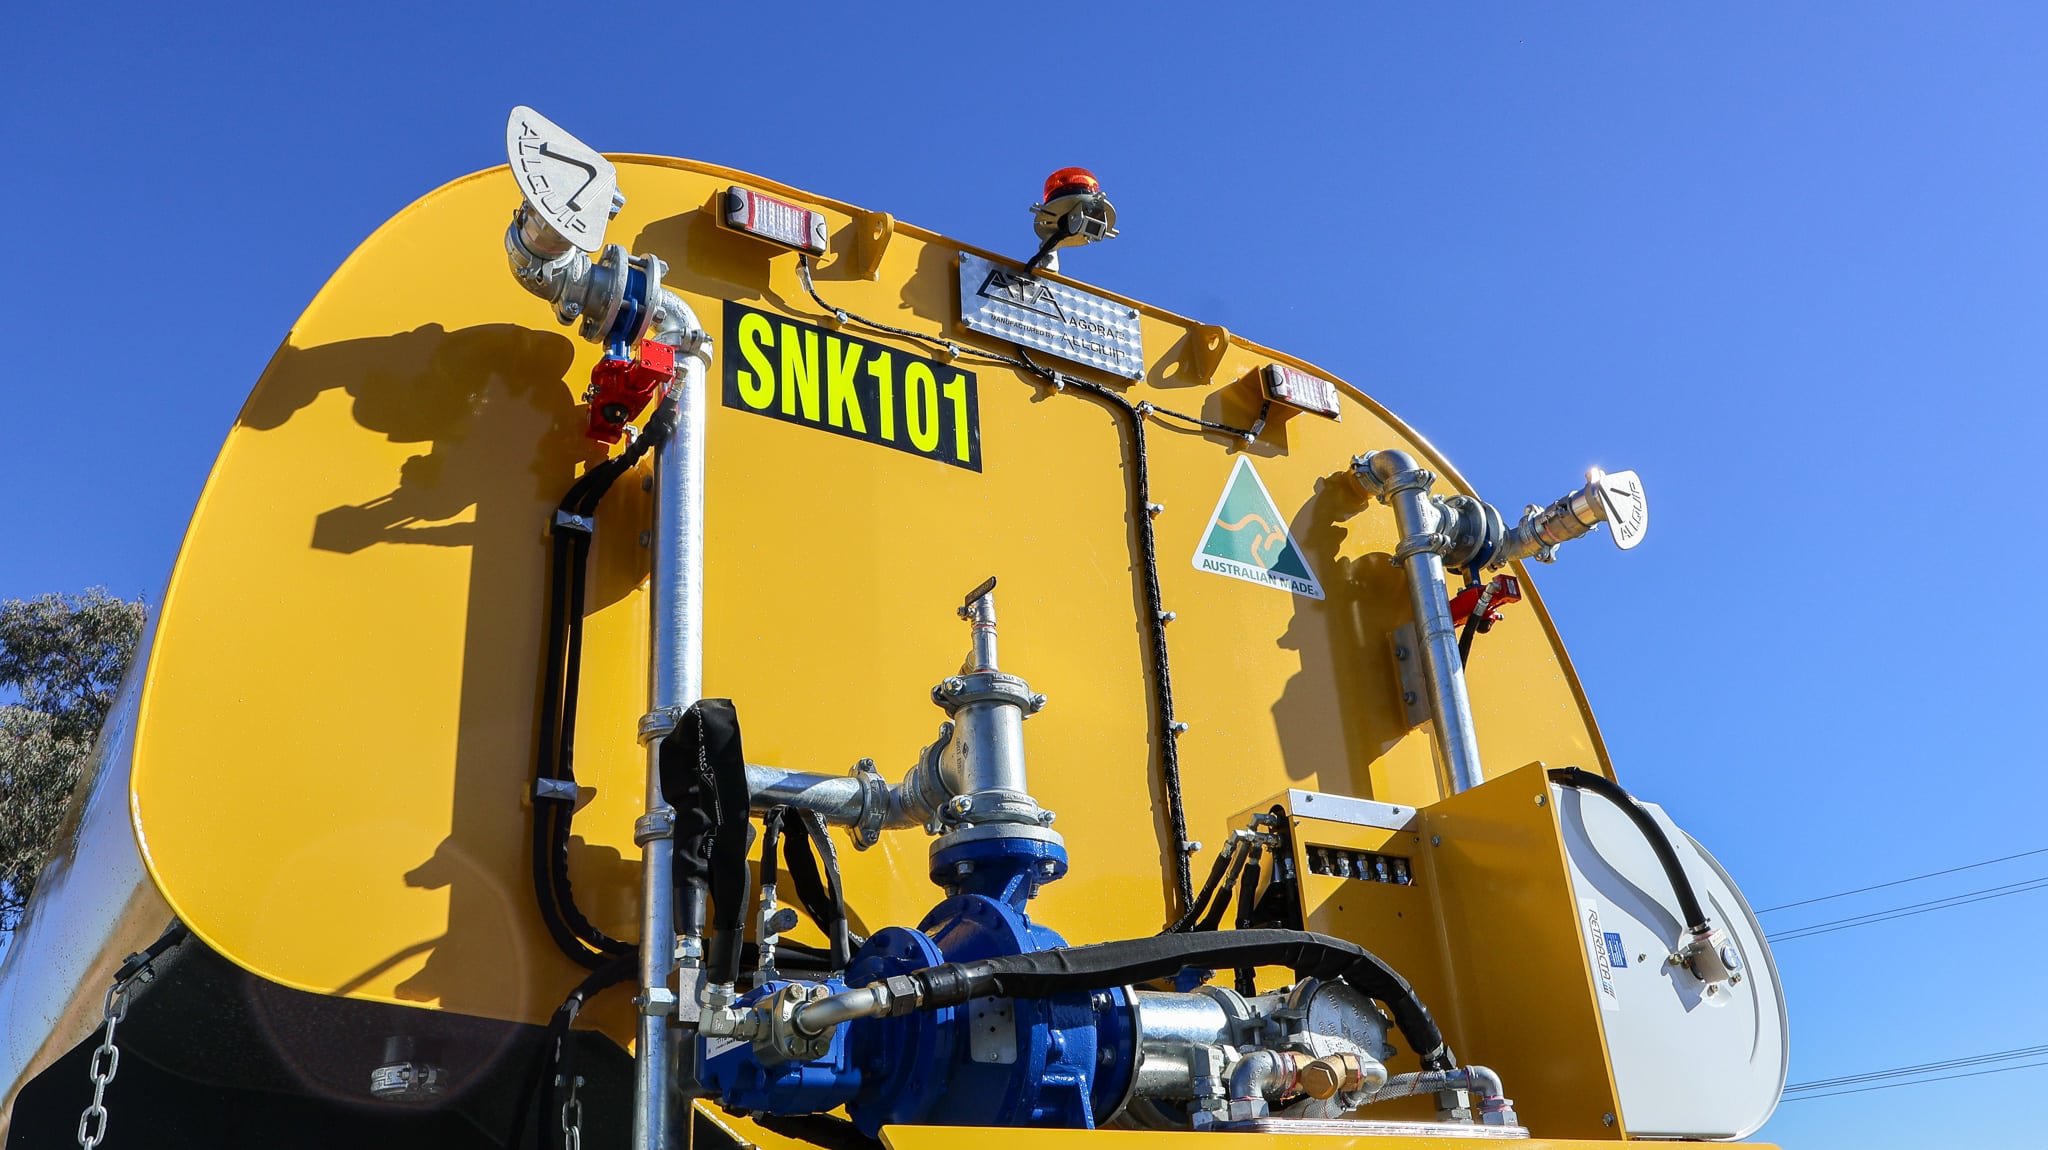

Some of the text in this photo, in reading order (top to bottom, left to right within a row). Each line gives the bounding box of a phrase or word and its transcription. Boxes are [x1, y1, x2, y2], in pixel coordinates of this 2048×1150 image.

[976, 269, 1067, 323] ATA
[991, 314, 1045, 337] MANUFACTURED
[1069, 316, 1117, 341] AGORA
[1061, 332, 1125, 365] ALLQUIP
[737, 312, 970, 463] SNK101
[1202, 558, 1314, 596] AUSTRALIAN MADE
[1588, 908, 1611, 981] RETRACTA
